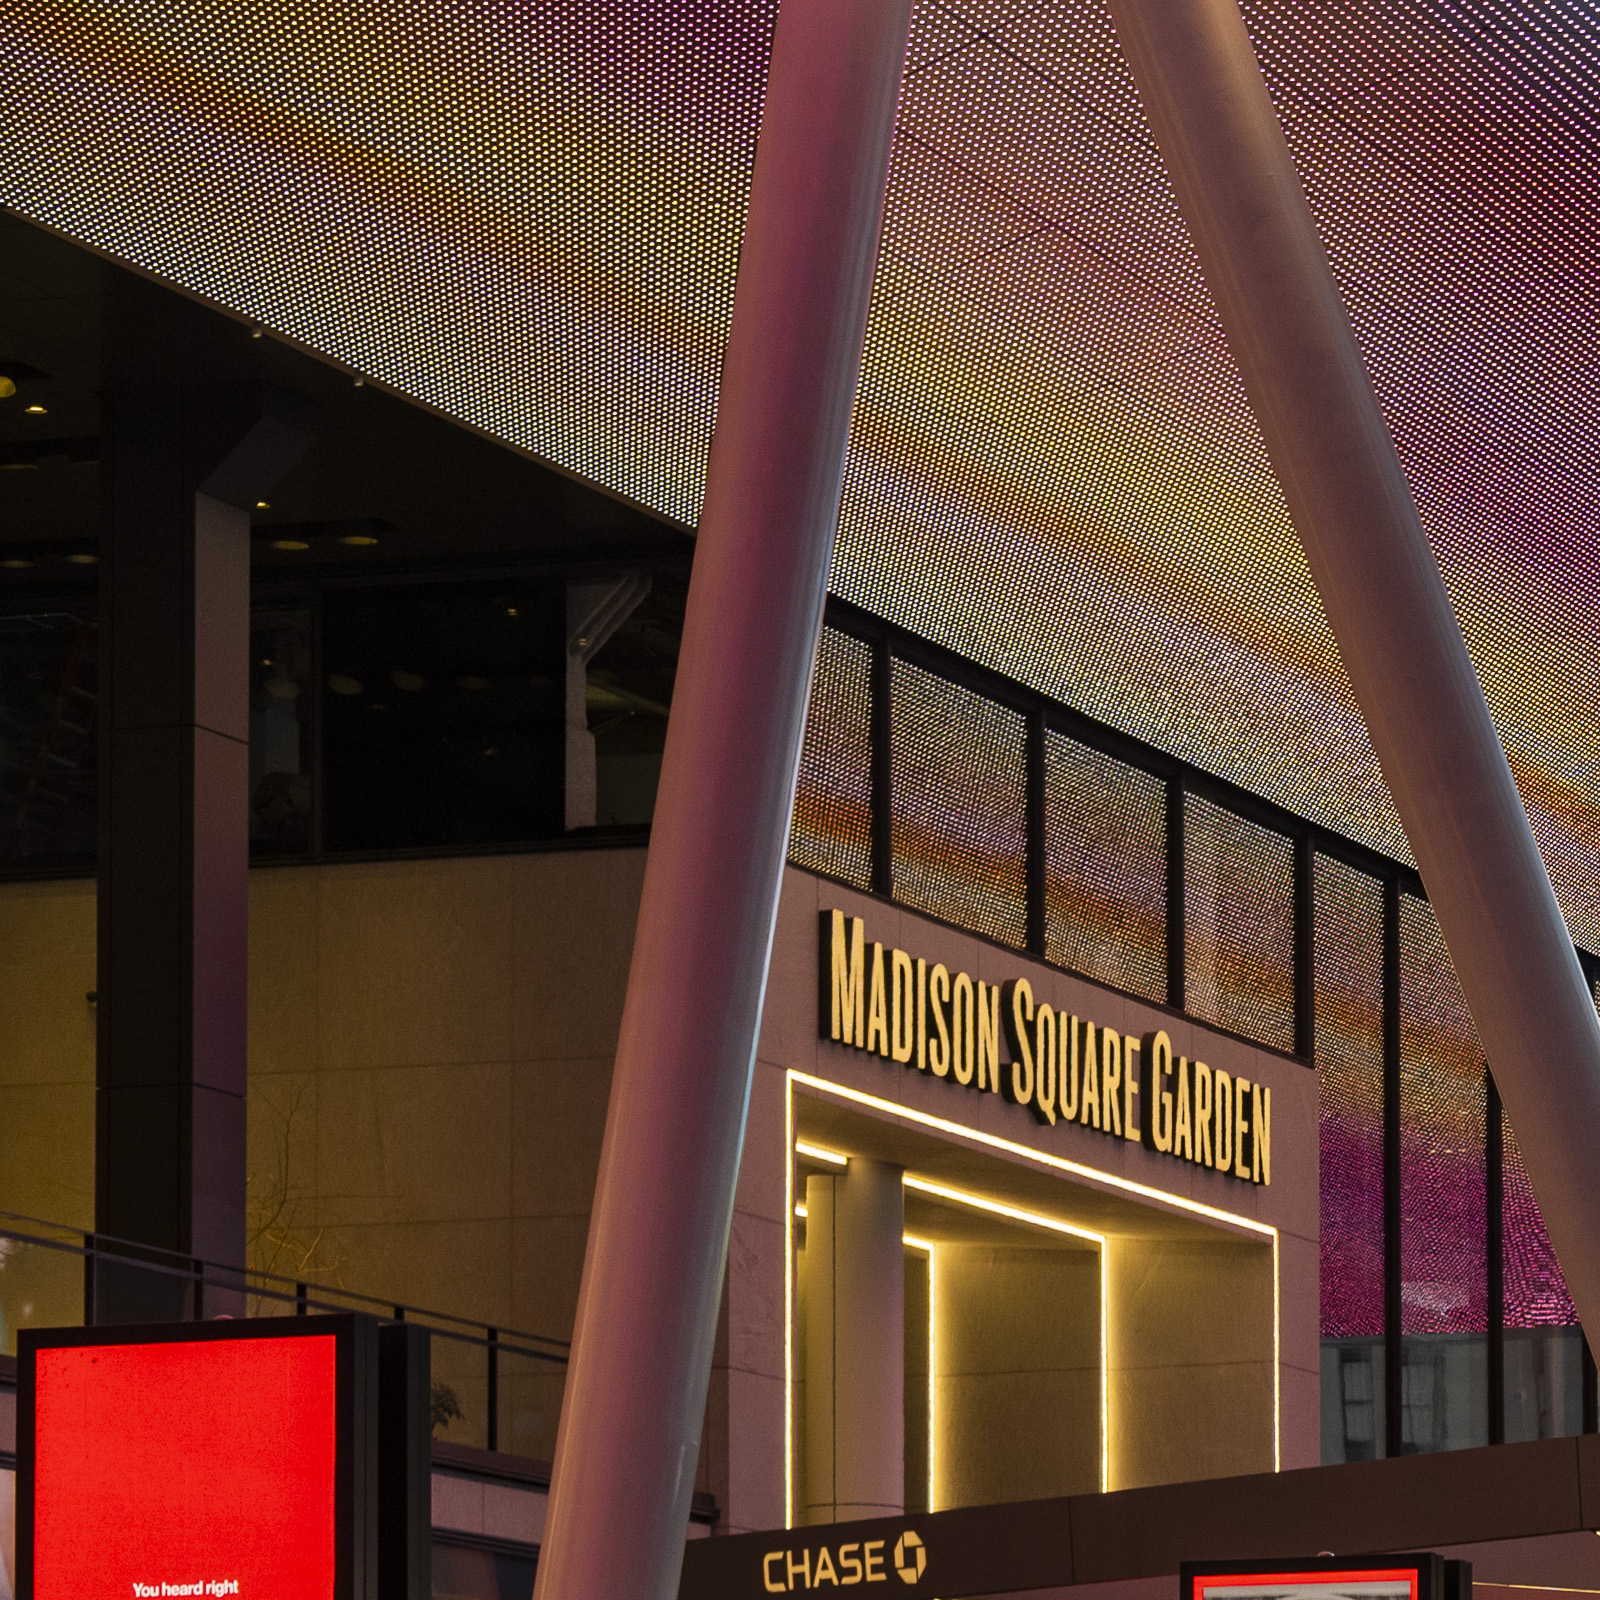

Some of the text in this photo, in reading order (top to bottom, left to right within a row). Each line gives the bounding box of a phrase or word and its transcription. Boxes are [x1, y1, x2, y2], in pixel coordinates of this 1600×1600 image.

[829, 908, 1271, 1186] MADISON SQUARE GARDEN
[133, 1579, 239, 1598] You heard right
[763, 1540, 887, 1594] CHASE
